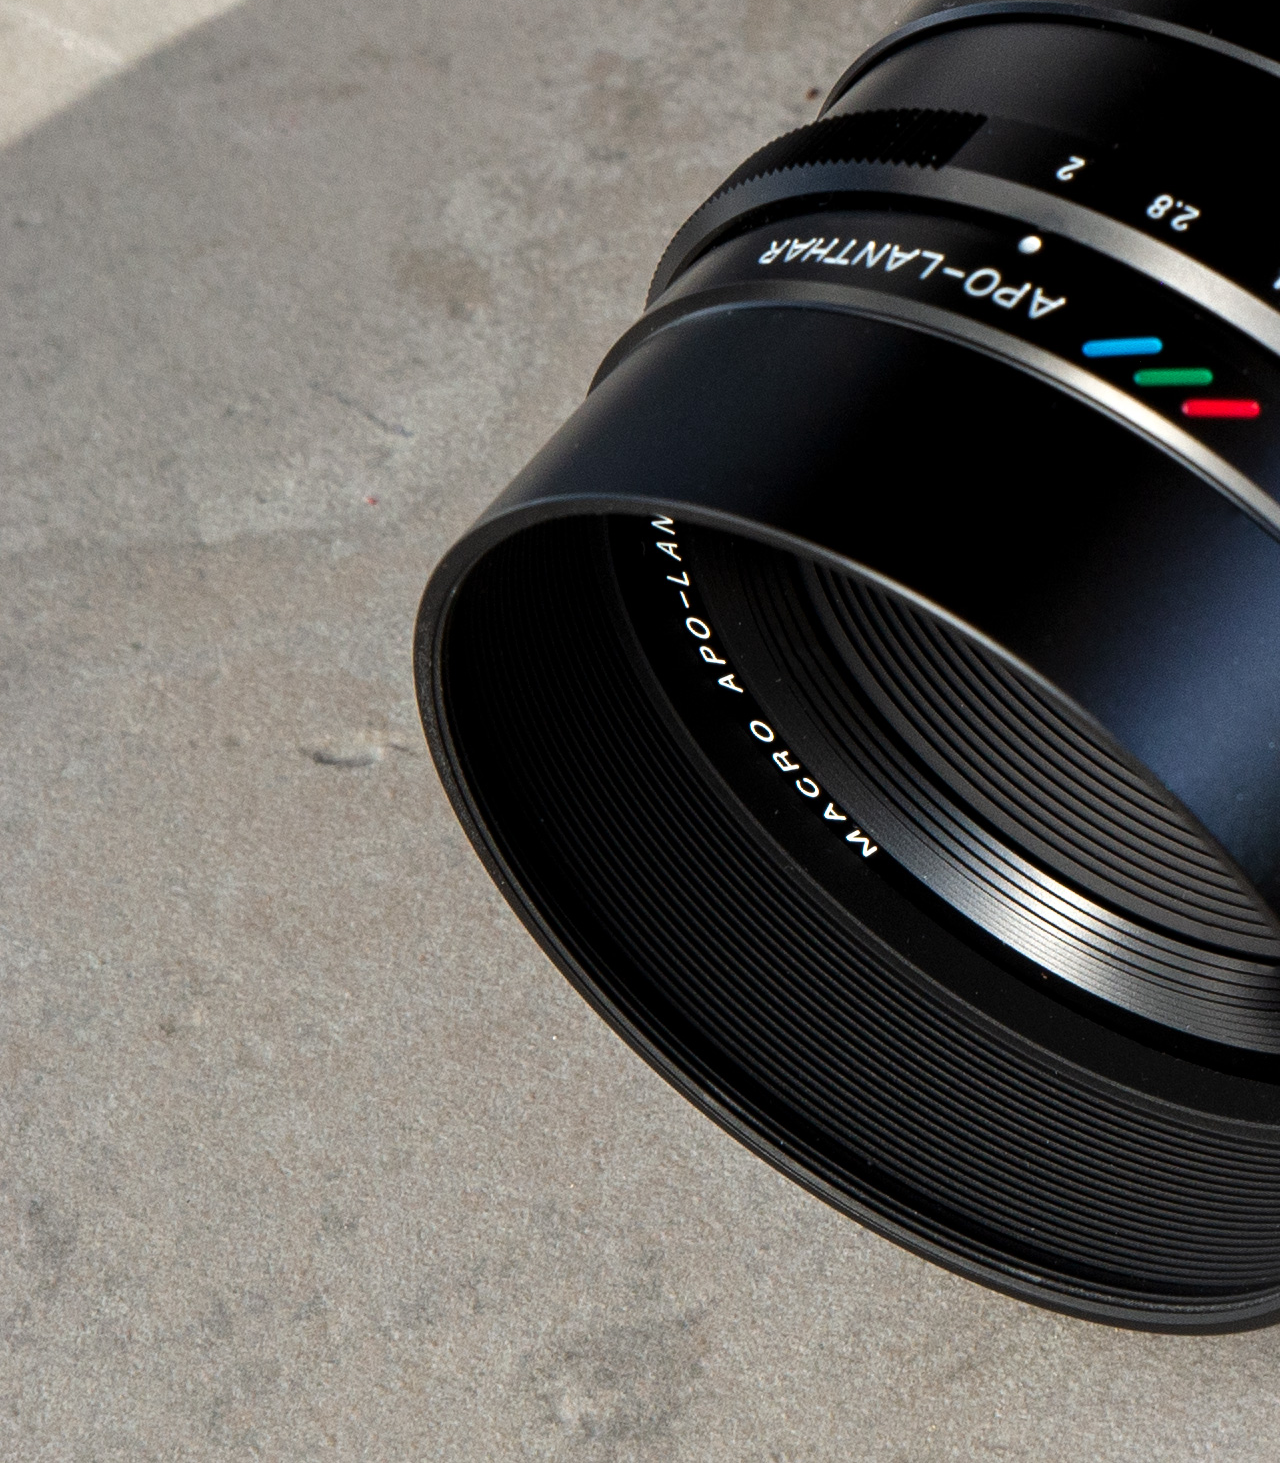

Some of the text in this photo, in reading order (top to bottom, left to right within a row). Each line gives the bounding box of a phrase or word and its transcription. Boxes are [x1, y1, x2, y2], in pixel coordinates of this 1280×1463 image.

[1056, 156, 1086, 180] 2
[1147, 195, 1200, 231] 2.8
[758, 236, 1067, 319] APO-LANTHAR
[750, 720, 877, 857] MACRO
